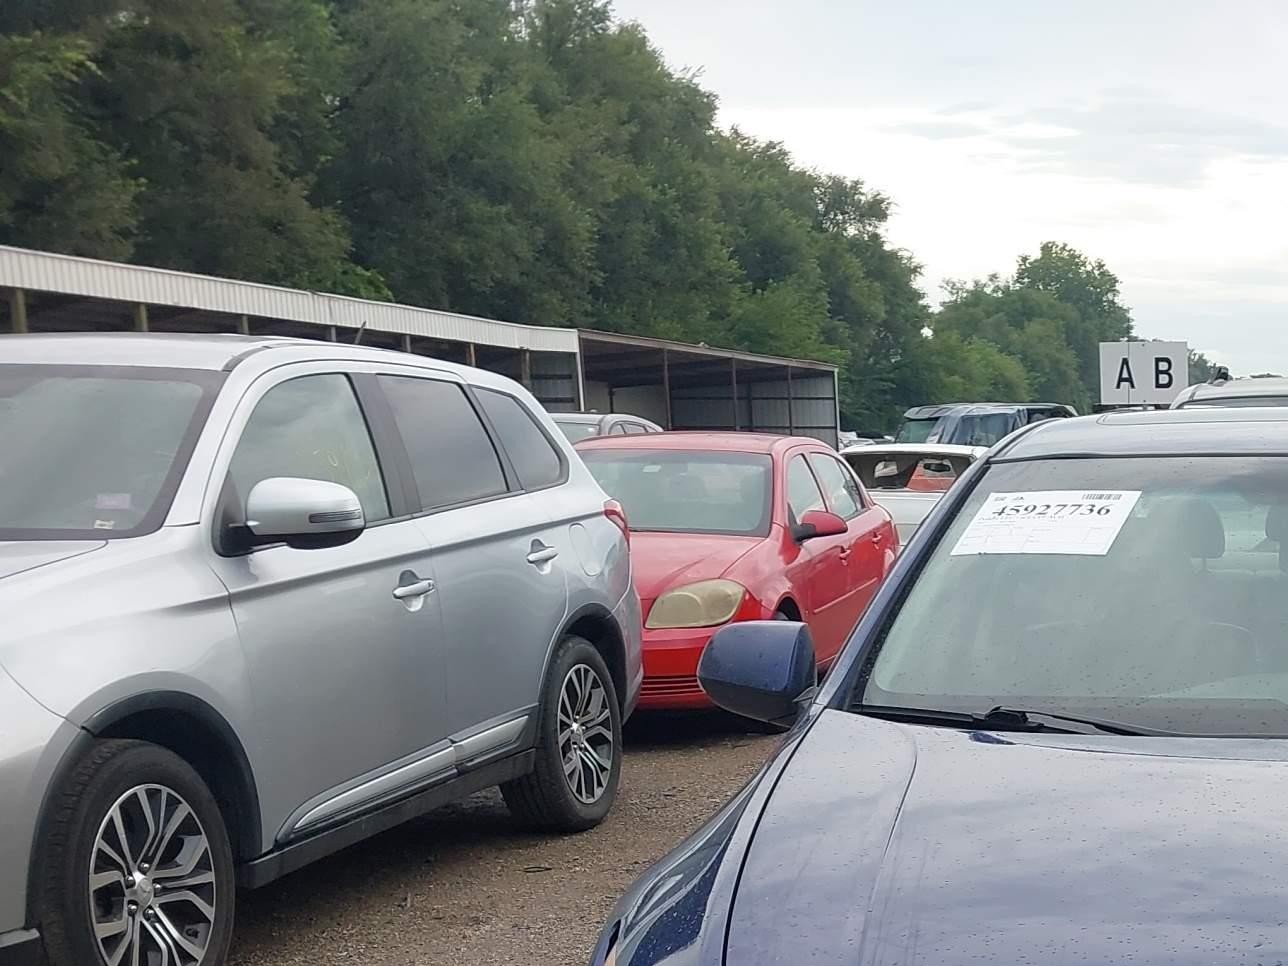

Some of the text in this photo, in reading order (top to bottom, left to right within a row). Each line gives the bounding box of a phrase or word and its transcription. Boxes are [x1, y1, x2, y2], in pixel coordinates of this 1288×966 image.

[1115, 356, 1173, 389] A B
[991, 503, 1113, 517] 45927736
